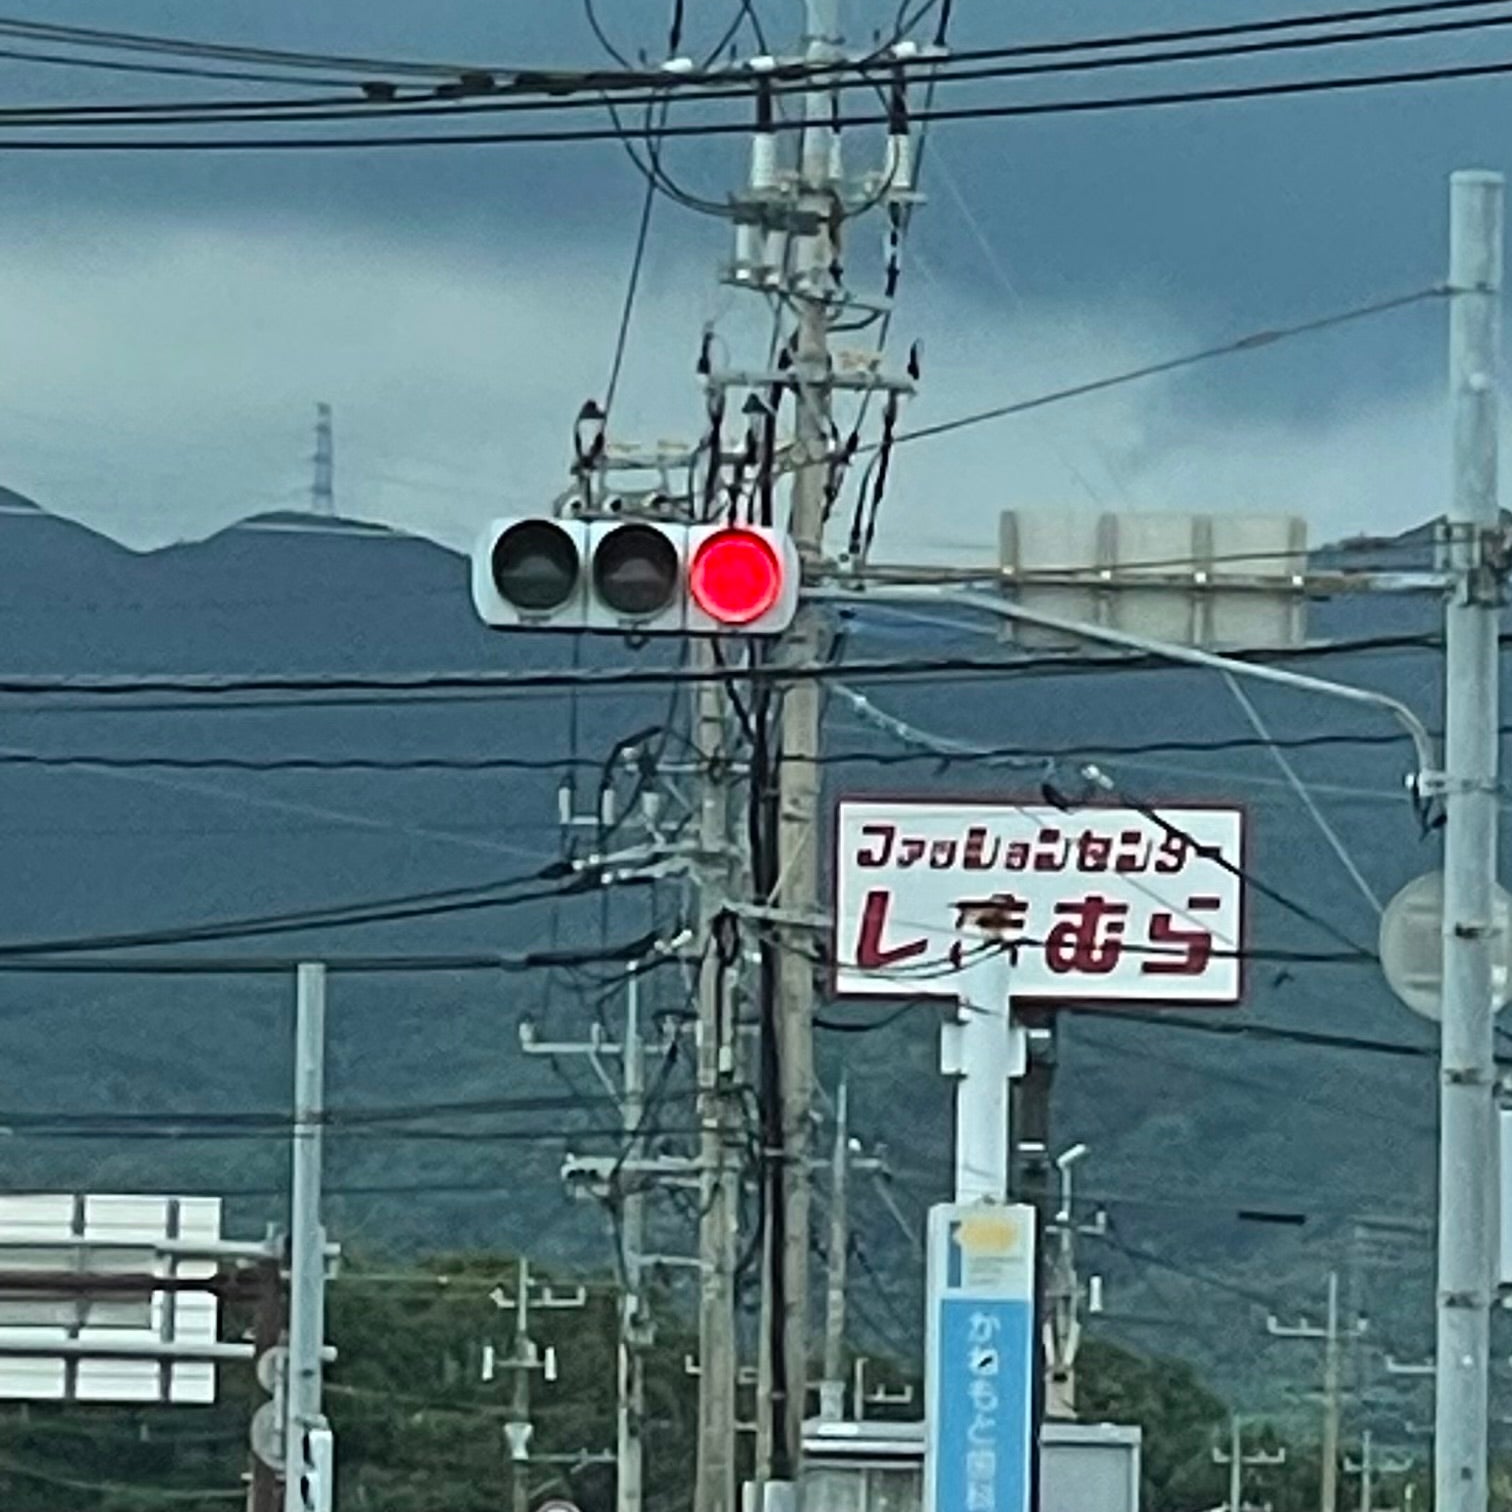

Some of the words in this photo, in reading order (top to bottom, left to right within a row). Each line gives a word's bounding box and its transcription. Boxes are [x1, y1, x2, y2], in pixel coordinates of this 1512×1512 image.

[857, 825, 1221, 873] ファッションセンター
[857, 890, 1221, 975] しまむら
